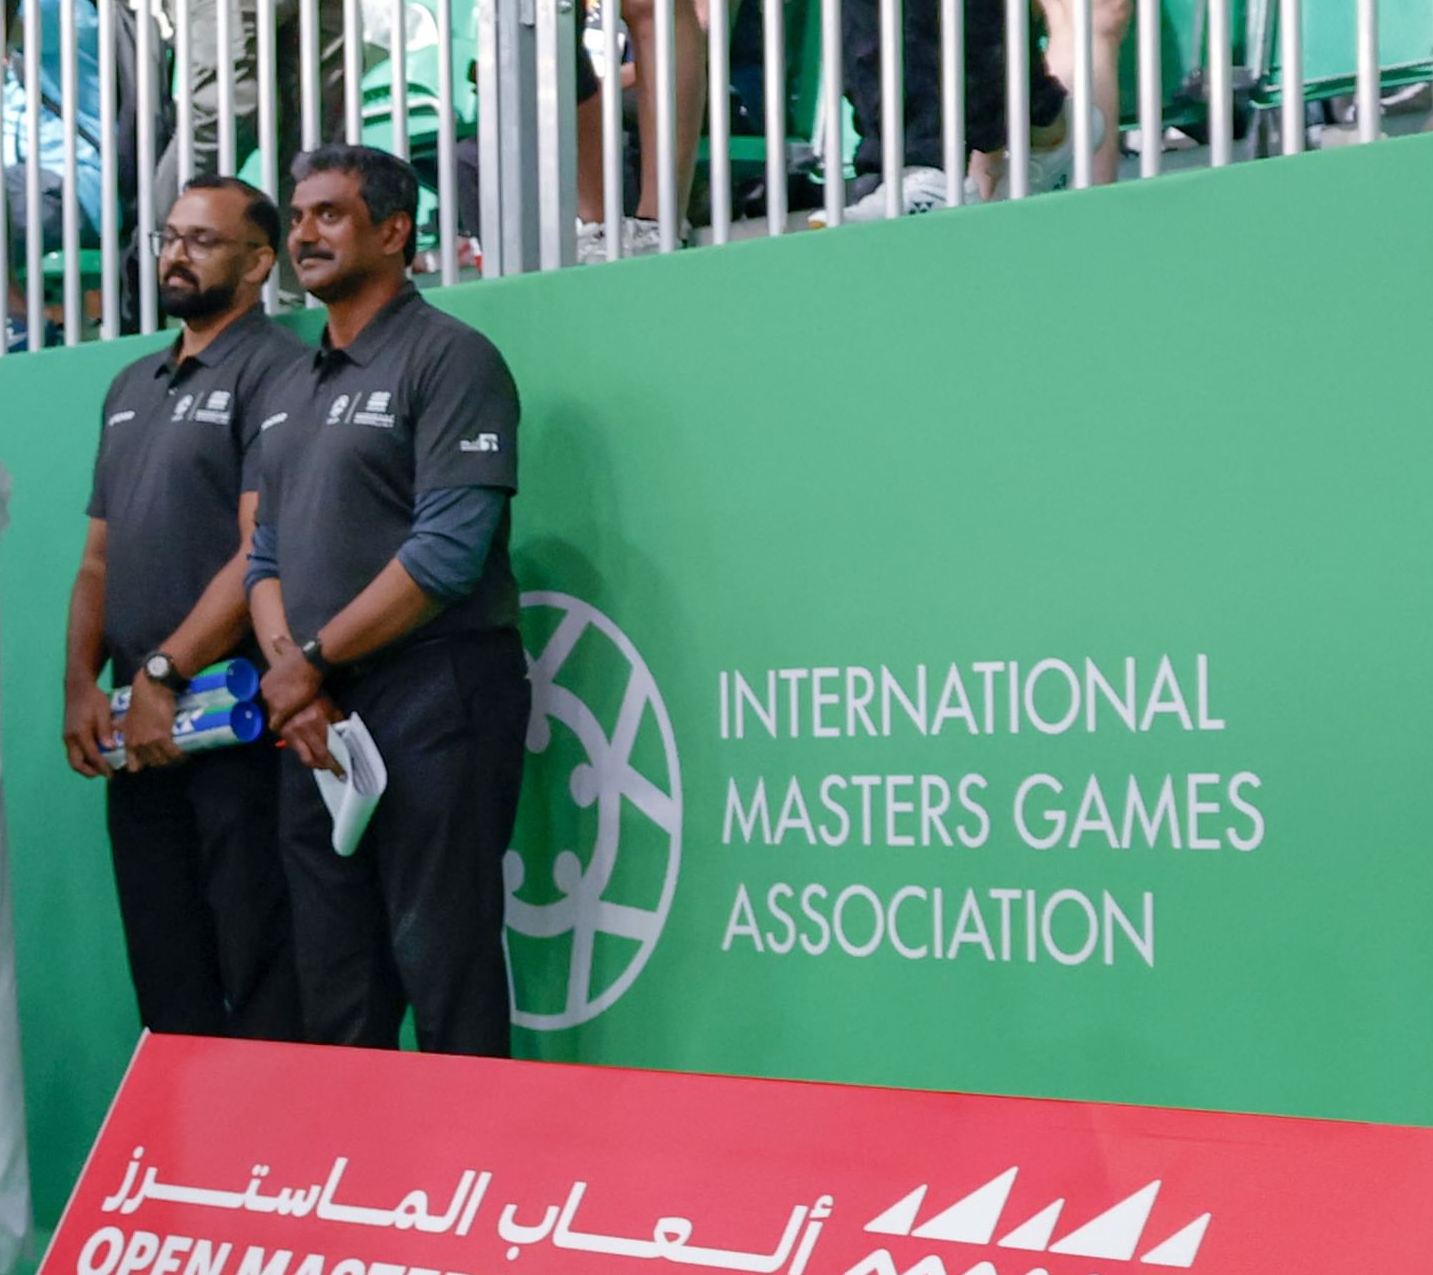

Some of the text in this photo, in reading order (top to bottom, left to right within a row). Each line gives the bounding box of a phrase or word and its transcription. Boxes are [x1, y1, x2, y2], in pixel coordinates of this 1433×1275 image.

[720, 653, 1226, 739] INTERNATIONAL
[723, 771, 1265, 851] MASTERS GAMES
[722, 883, 1154, 967] ASSOCIATION
[102, 1146, 492, 1237] الماسترز
